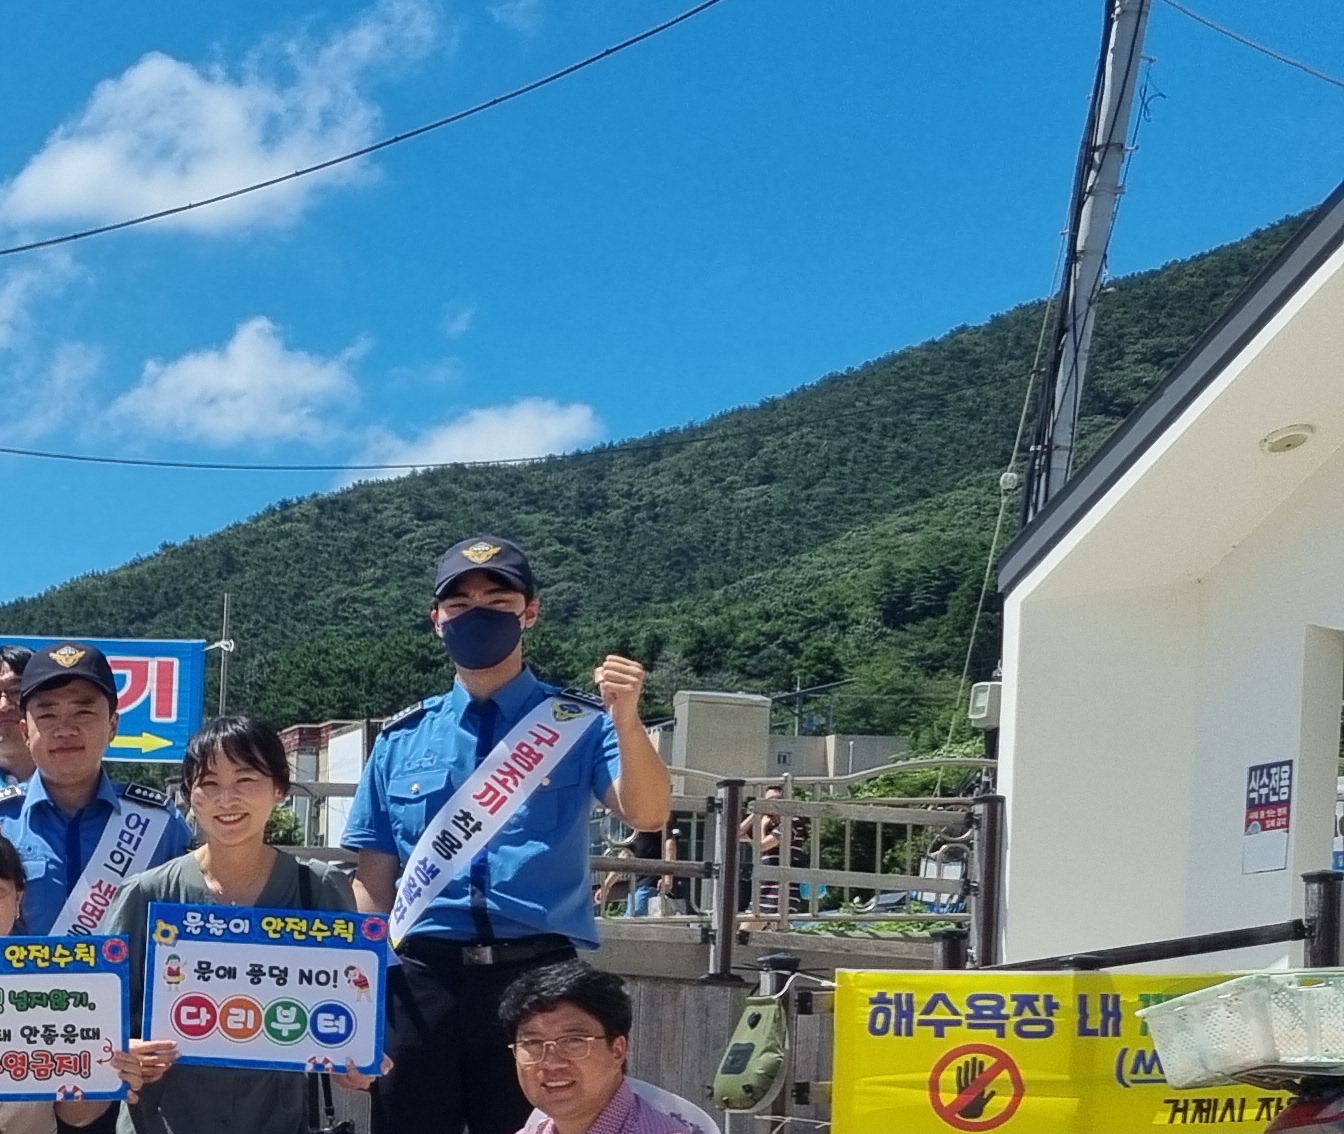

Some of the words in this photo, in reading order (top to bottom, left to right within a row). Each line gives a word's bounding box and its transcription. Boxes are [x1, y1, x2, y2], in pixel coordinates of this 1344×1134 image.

[472, 723, 561, 816] 구명조끼
[1248, 765, 1290, 805] 식수전용
[103, 812, 151, 878] 어민의
[431, 808, 483, 861] 착용
[182, 911, 250, 936] 물놀이
[261, 916, 355, 942] 안전수칙
[4, 943, 97, 968] 안전수칙
[193, 960, 237, 982] 물에
[246, 963, 289, 986] 풍덩
[298, 968, 339, 988] NO!
[868, 991, 1060, 1038] 해수욕장
[1077, 993, 1122, 1037] 내
[20, 1023, 101, 1045] 안좋을때
[1163, 1097, 1247, 1124] 거제시
[1255, 1097, 1295, 1122] 자
